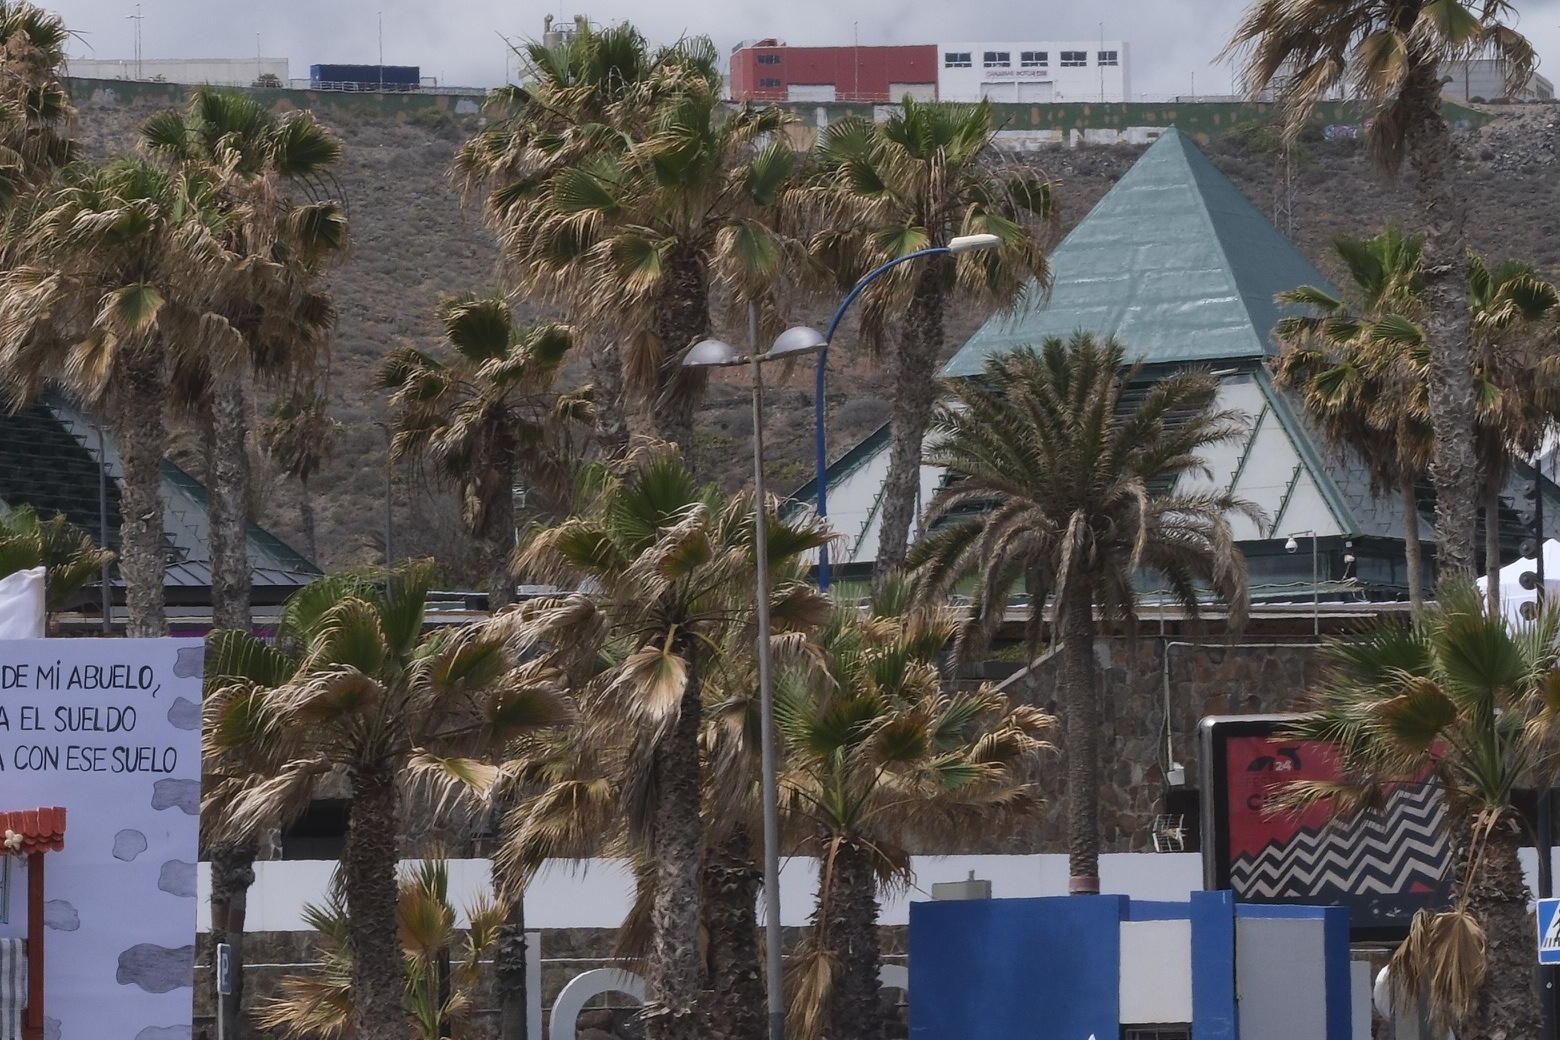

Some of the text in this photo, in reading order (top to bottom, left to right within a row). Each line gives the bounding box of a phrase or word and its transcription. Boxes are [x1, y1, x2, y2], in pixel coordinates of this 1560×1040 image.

[2, 664, 29, 690] DE
[67, 664, 161, 698] ABUELO,
[20, 706, 46, 731] EL
[54, 705, 137, 733] SUELDO
[13, 744, 59, 771] CON
[66, 745, 108, 772] ESE
[111, 745, 178, 774] SUELO
